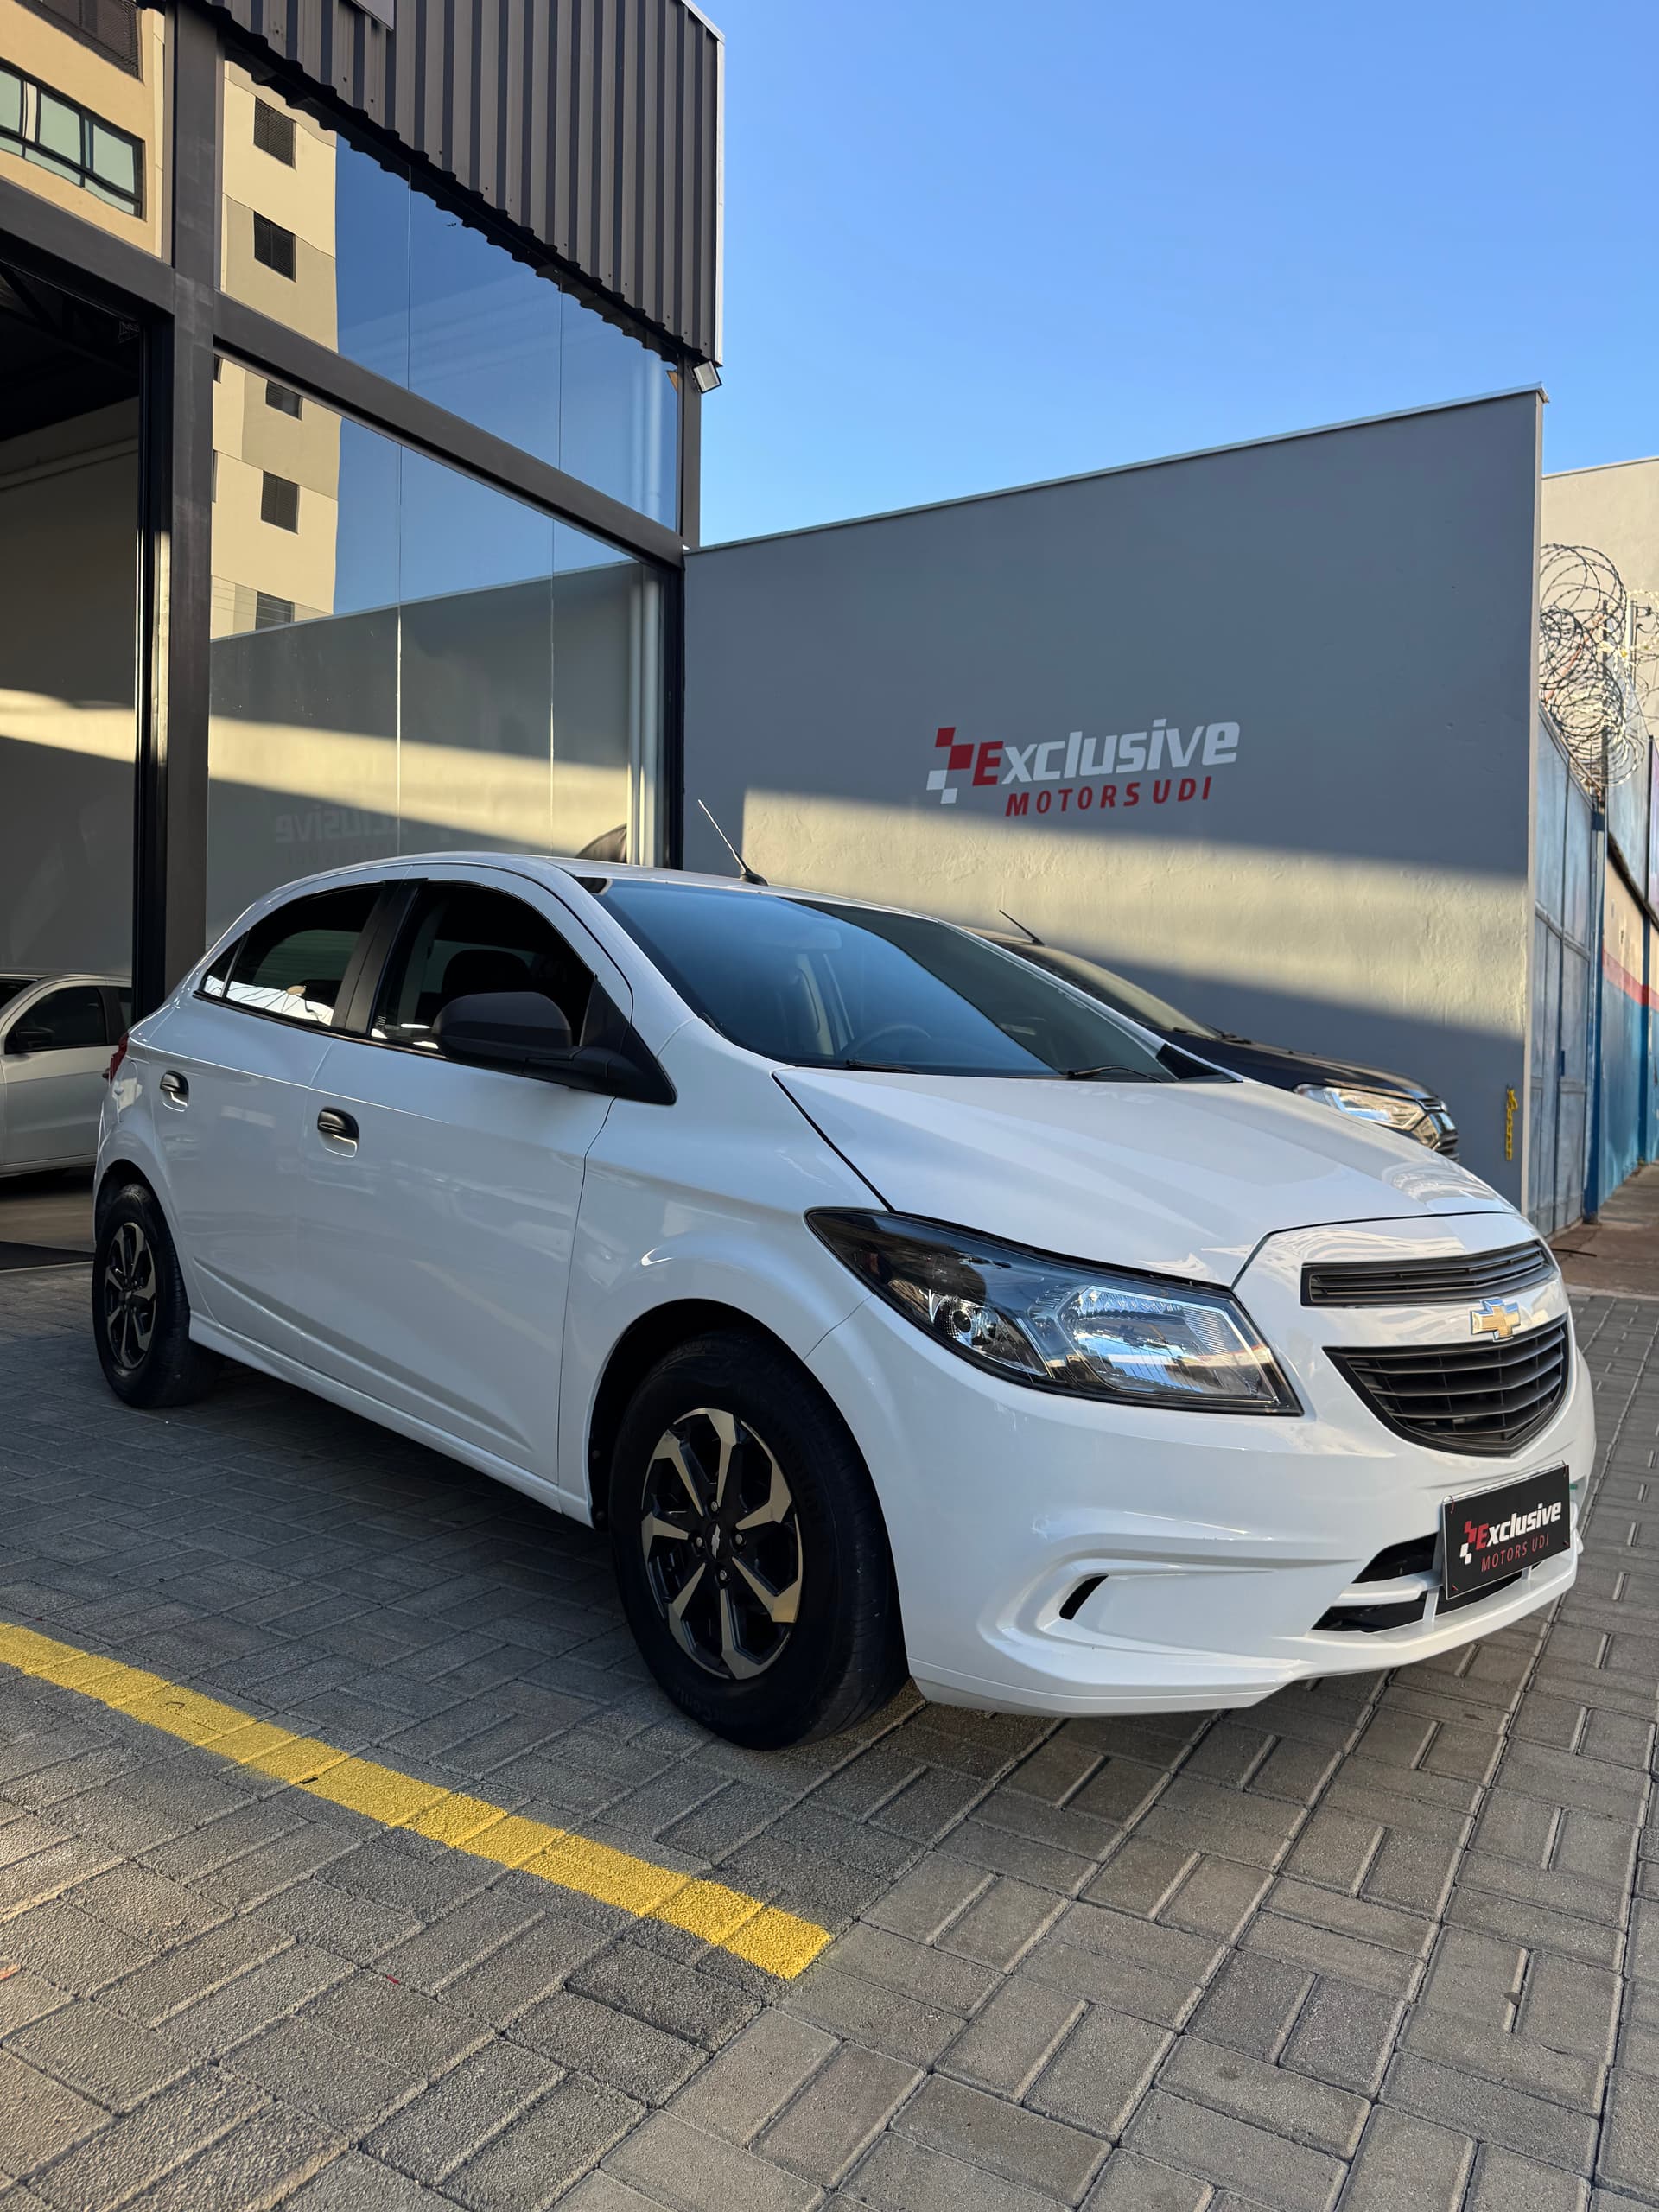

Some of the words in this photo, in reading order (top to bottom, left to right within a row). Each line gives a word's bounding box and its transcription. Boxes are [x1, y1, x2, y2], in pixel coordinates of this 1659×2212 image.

[972, 718, 1240, 786] Exclusive
[1005, 782, 1140, 817] MOTORS
[1153, 776, 1212, 804] UDI
[1476, 1501, 1562, 1550] Exclusive
[1481, 1541, 1528, 1572] MOTORS
[1531, 1533, 1549, 1552] UDI
